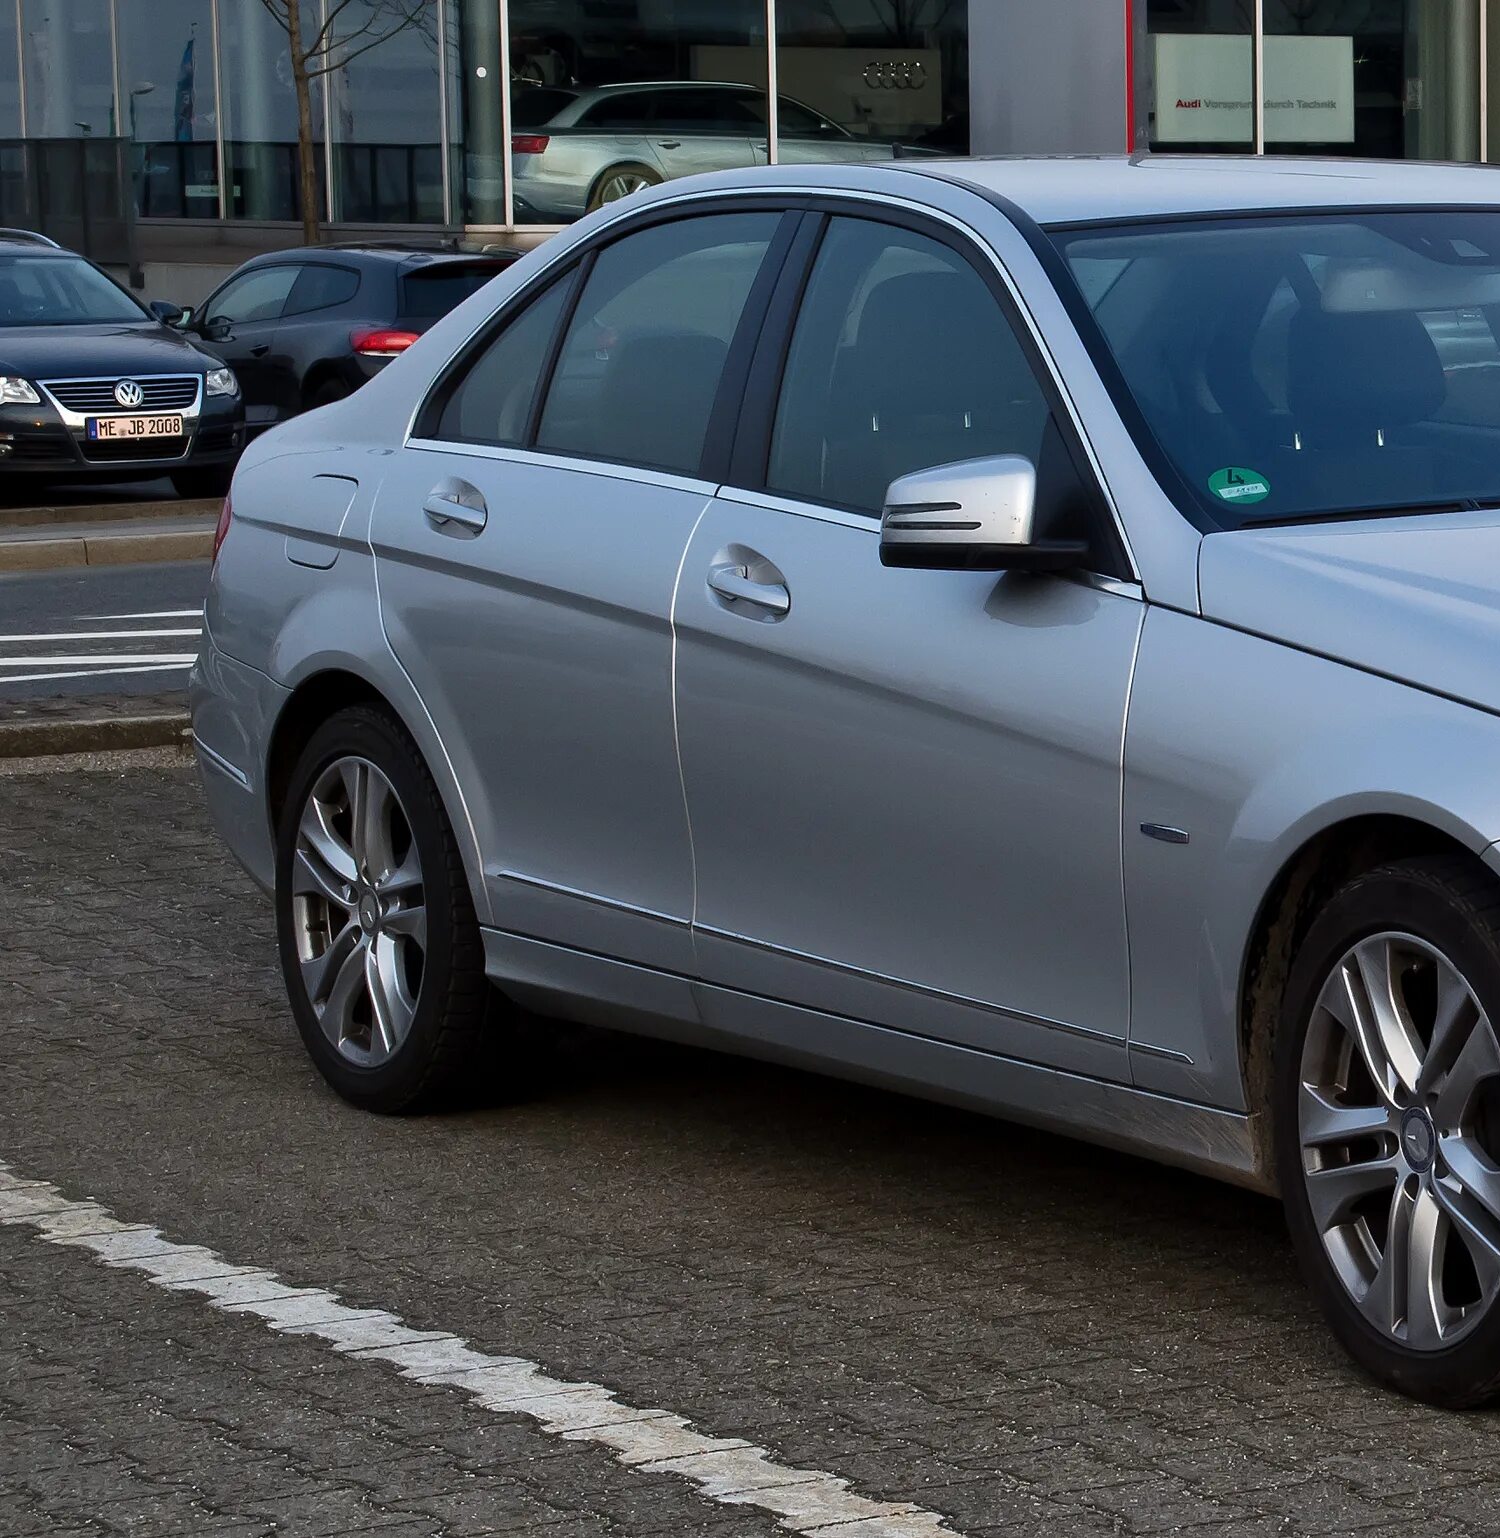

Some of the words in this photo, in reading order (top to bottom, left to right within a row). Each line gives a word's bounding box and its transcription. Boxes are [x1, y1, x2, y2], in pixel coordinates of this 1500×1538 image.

[1176, 99, 1201, 109] Audi
[1204, 100, 1253, 110] Vorsprun
[1263, 99, 1294, 109] durch
[1297, 99, 1336, 109] Technik
[99, 421, 117, 436] ME
[128, 420, 145, 435] JB
[148, 418, 180, 434] 2008
